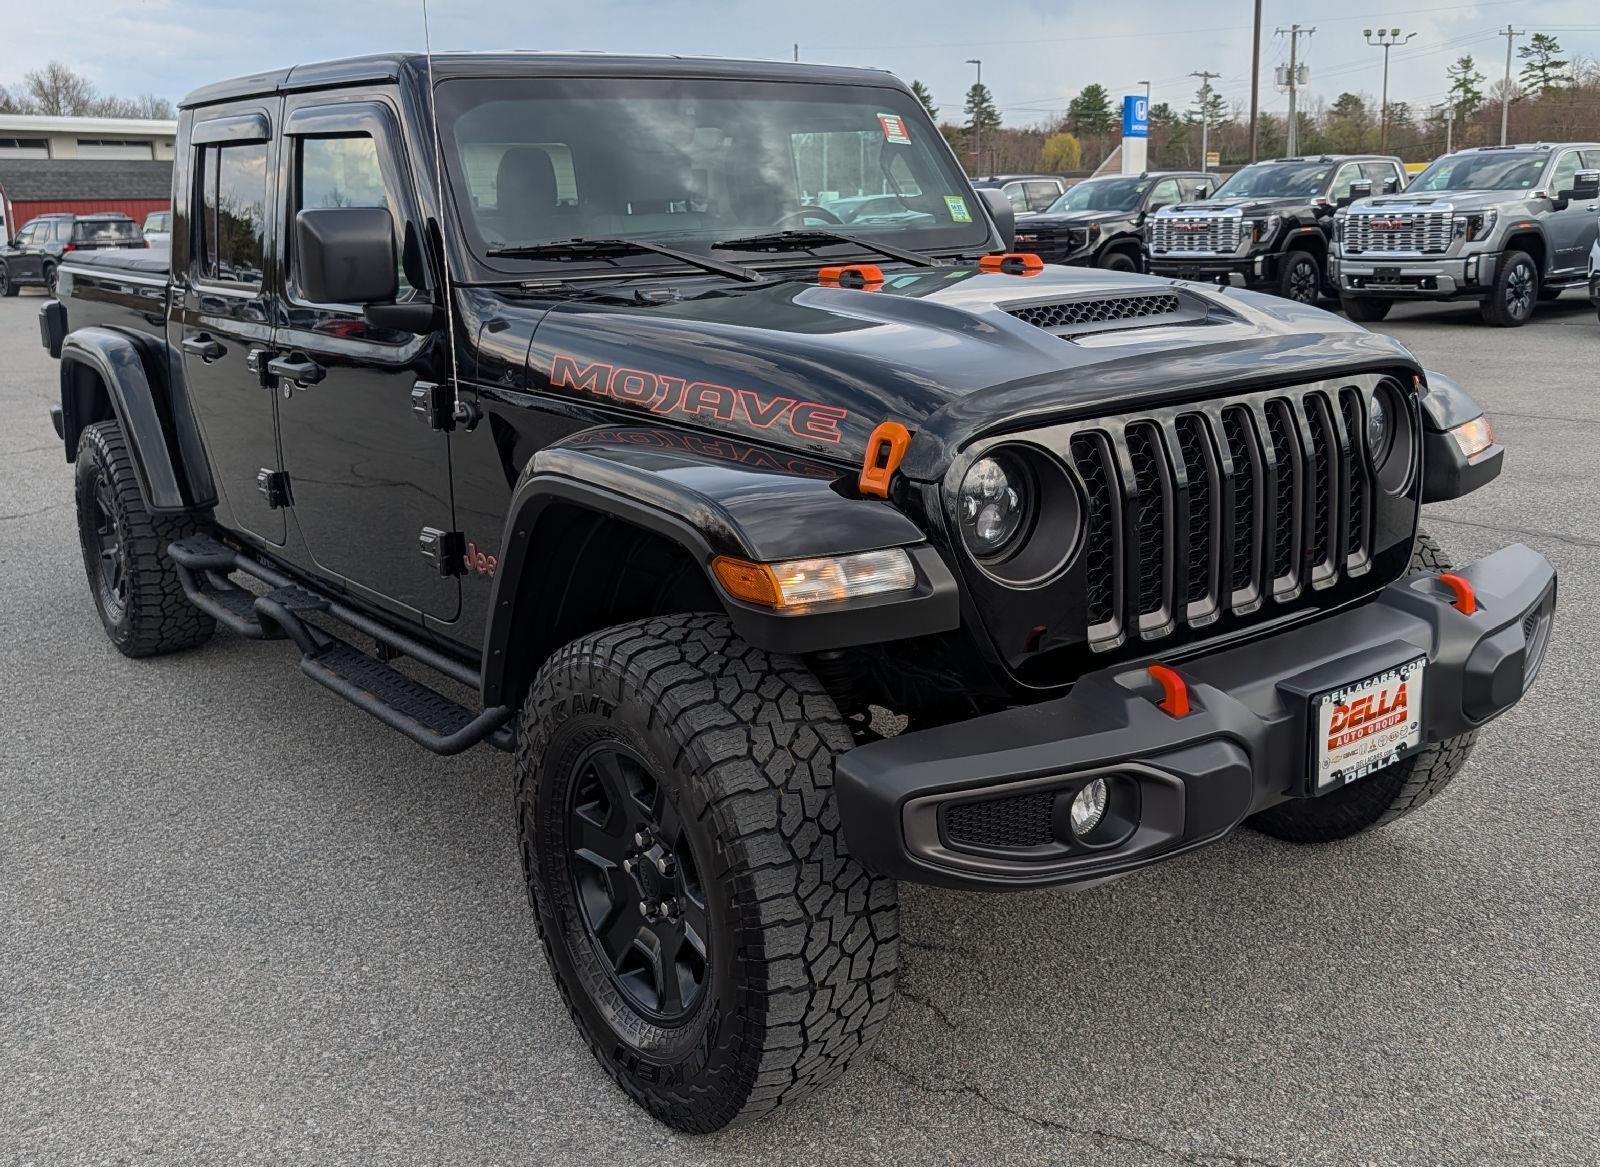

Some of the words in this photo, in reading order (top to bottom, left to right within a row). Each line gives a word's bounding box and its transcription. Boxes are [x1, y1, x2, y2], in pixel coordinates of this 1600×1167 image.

[551, 353, 848, 443] MOJAVE
[463, 542, 498, 577] Jee
[1322, 658, 1426, 706] DELLACARS.COM
[1328, 682, 1408, 735] DELLA
[1336, 725, 1363, 746] AUTO
[1368, 713, 1401, 734] GROUP
[1344, 753, 1400, 785] DELLA
